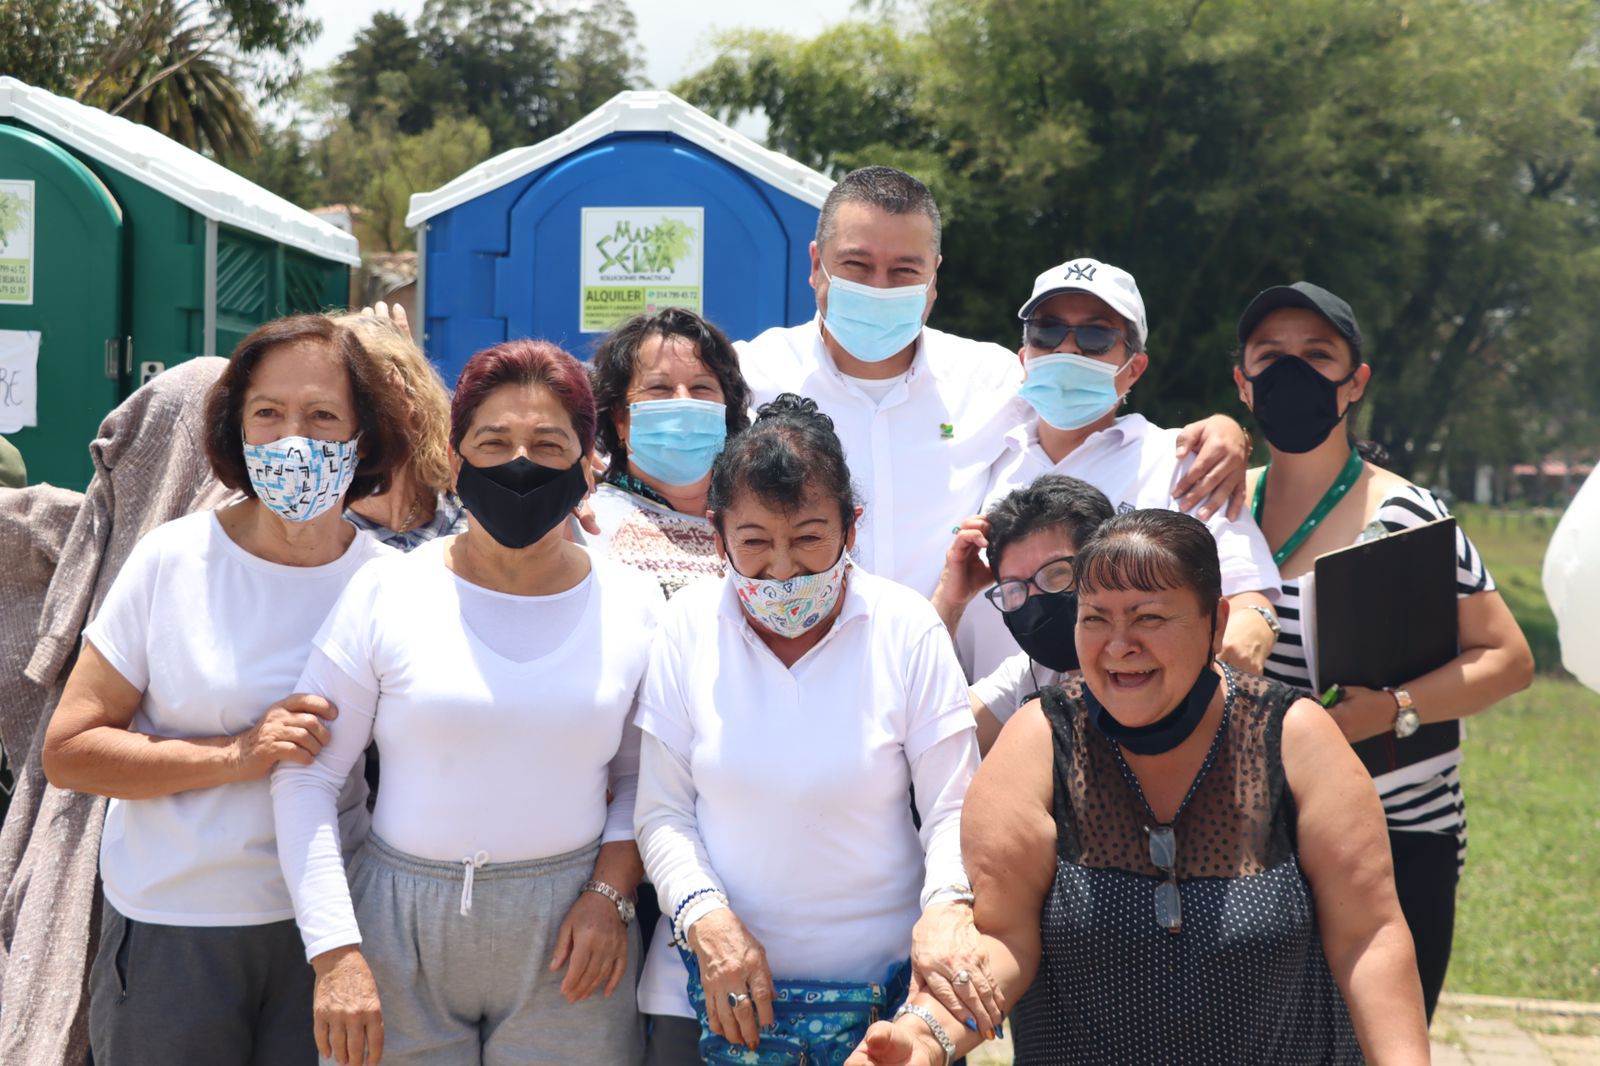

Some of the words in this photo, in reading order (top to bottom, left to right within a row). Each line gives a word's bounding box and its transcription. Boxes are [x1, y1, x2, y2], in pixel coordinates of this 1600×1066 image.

[614, 220, 676, 243] MADRE
[596, 234, 675, 274] SELVA
[586, 290, 641, 303] ALQUILER
